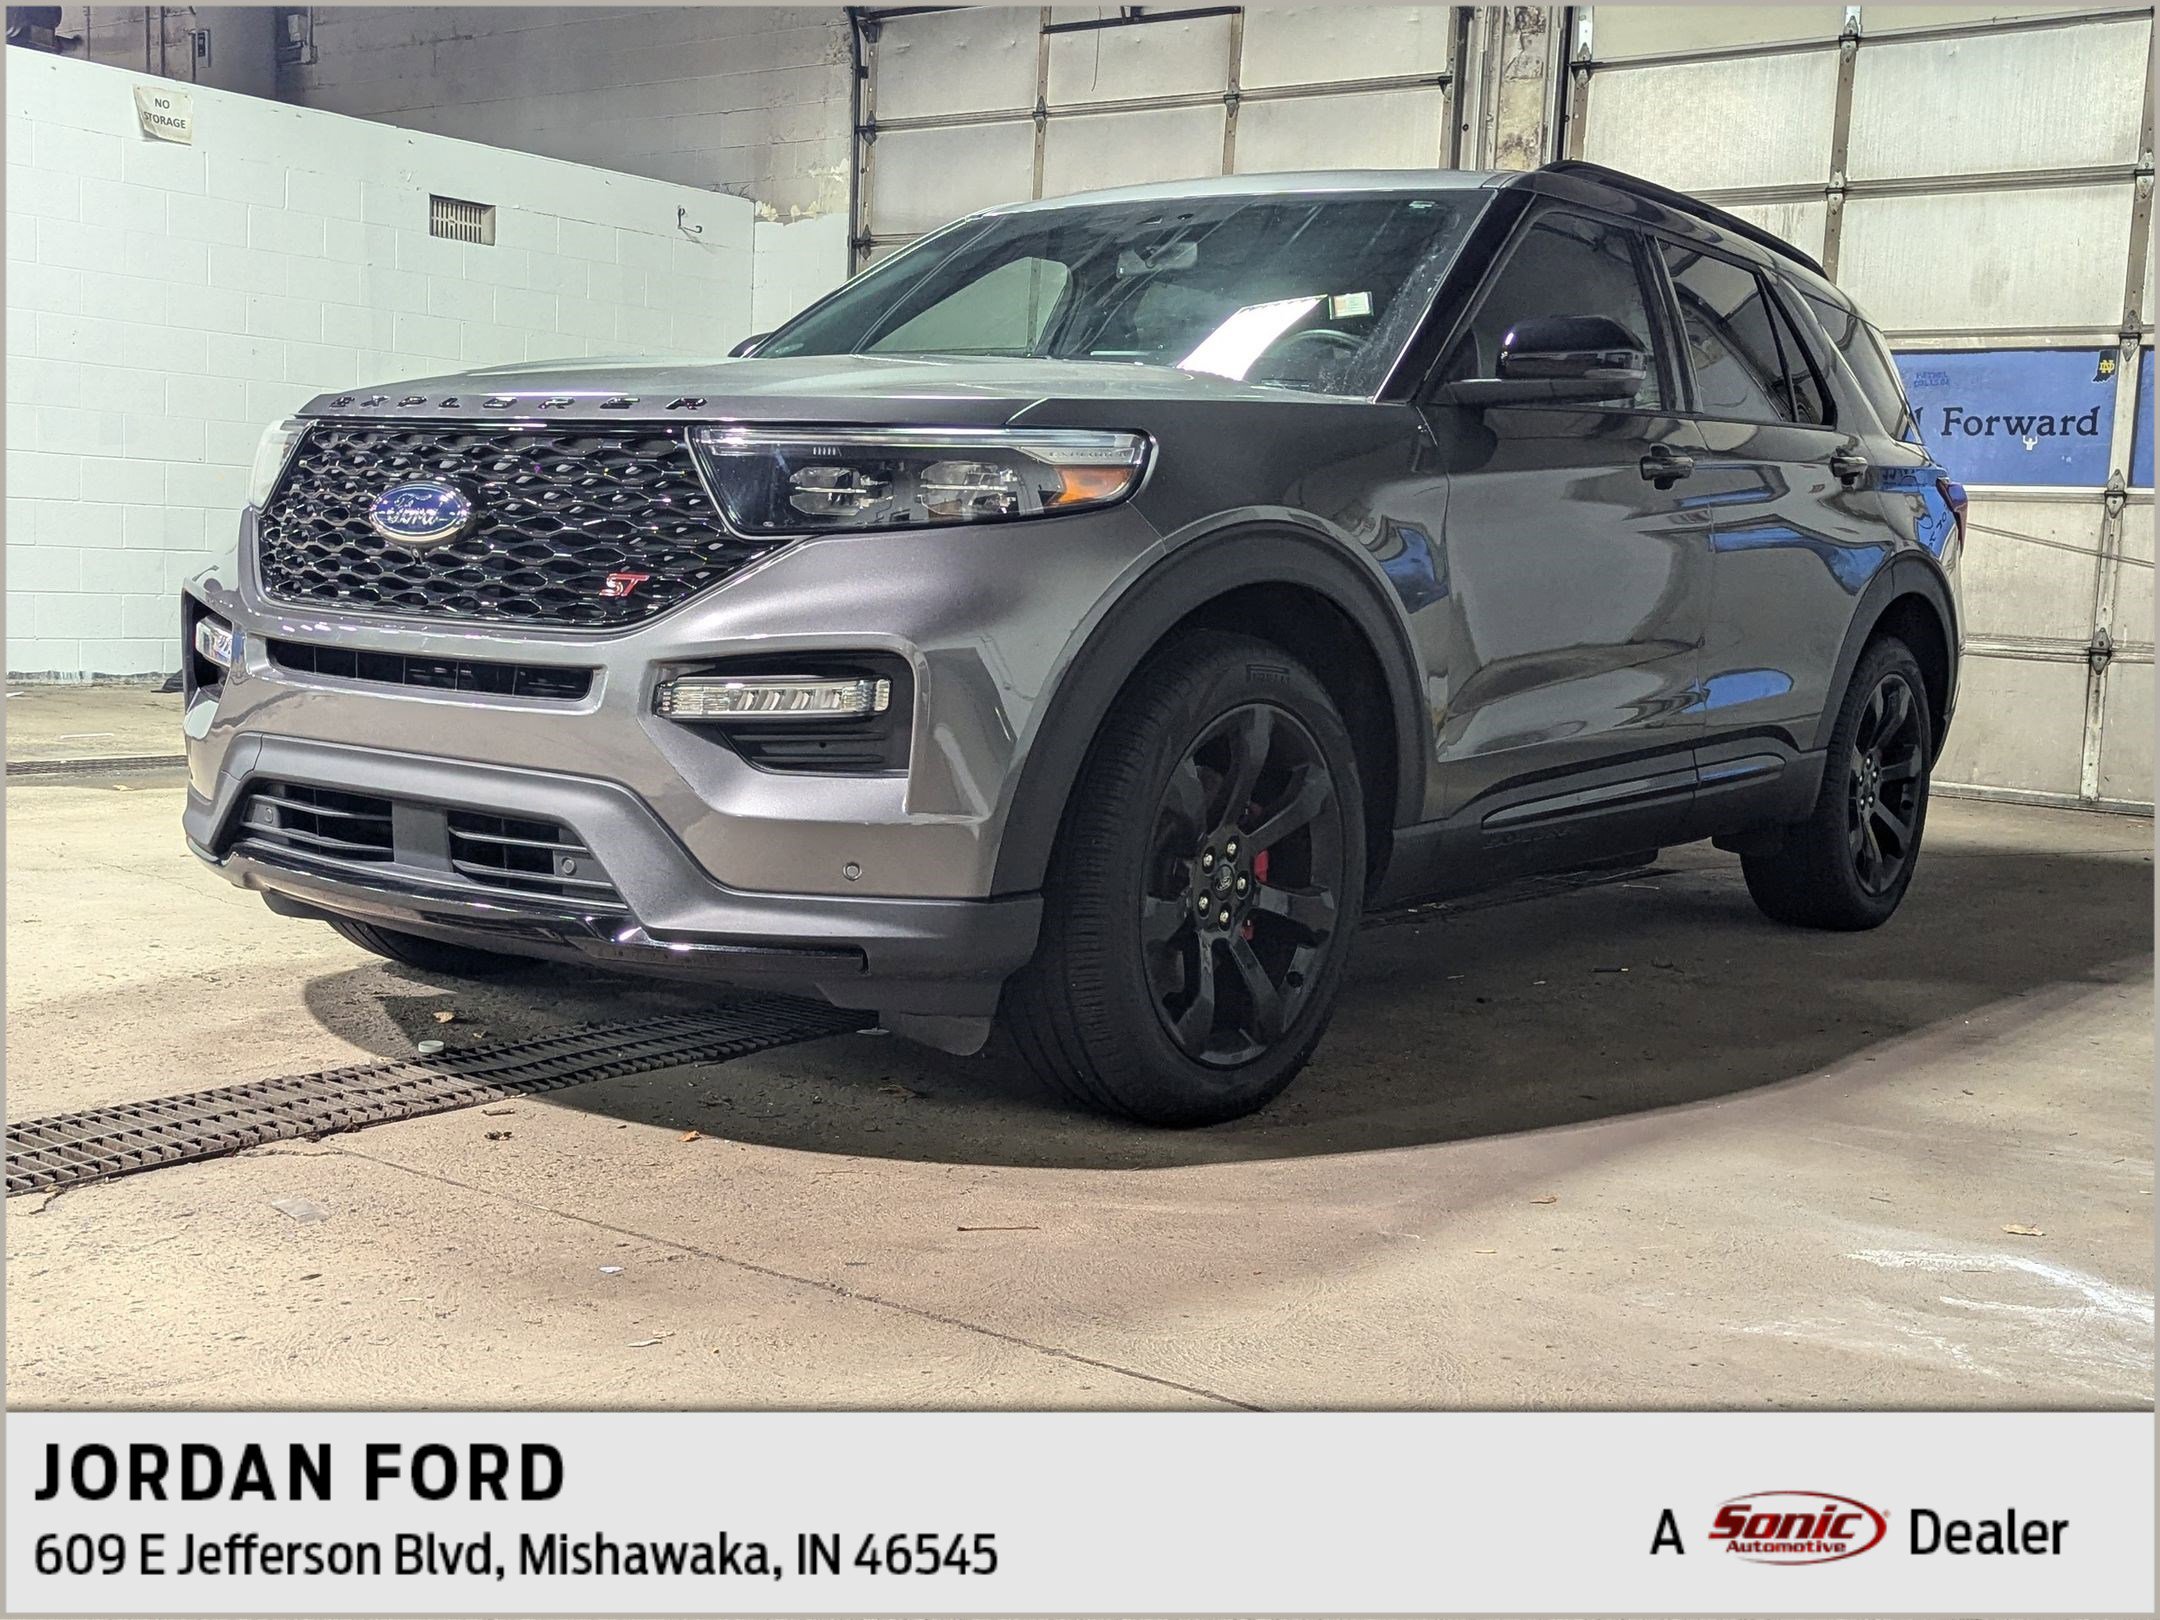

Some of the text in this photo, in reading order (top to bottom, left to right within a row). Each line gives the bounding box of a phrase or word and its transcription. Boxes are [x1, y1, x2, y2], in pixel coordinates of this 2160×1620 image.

[154, 98, 171, 110] NO
[143, 111, 187, 129] STORAGE
[1940, 404, 2101, 437] Forward
[386, 492, 440, 526] Ford
[599, 573, 651, 597] ST
